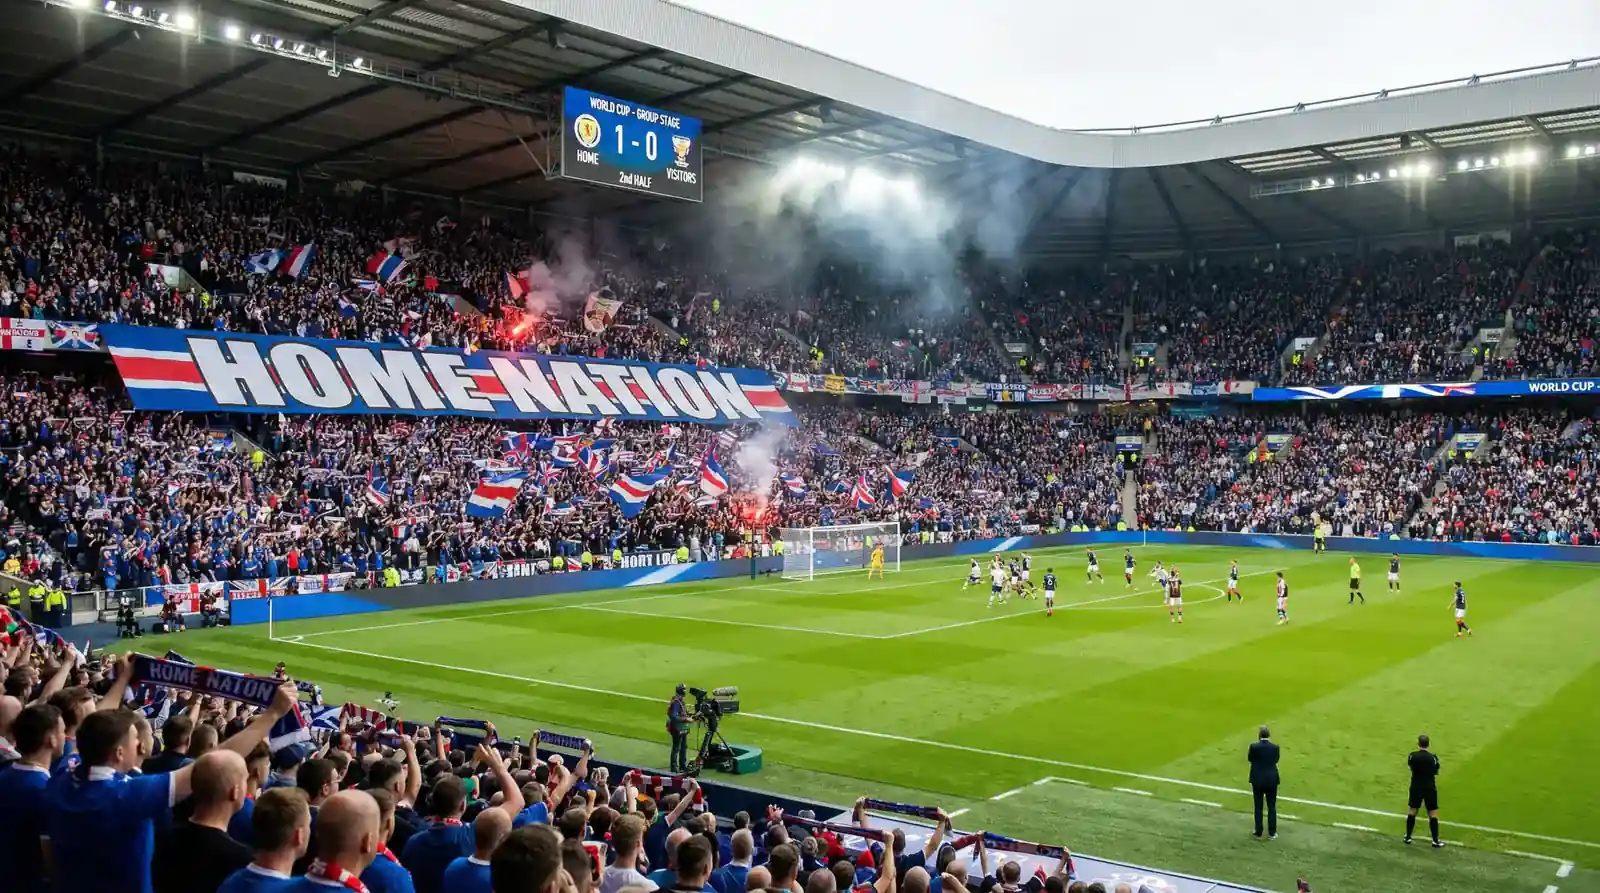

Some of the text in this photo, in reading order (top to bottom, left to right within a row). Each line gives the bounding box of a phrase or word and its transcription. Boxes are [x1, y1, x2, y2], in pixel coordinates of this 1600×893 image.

[589, 96, 614, 114] WORLD
[616, 103, 631, 117] CUP
[637, 109, 659, 123] GROUP
[660, 114, 681, 129] STAGE
[615, 124, 624, 154] 1
[645, 131, 658, 161] 0
[576, 149, 599, 165] HOME
[619, 171, 653, 188] 2nd HALF
[666, 167, 697, 184] VISITORS
[187, 338, 762, 419] HOME NATION
[1529, 382, 1569, 392] WORLD
[1572, 381, 1595, 391] CUP
[150, 662, 199, 684] HOME
